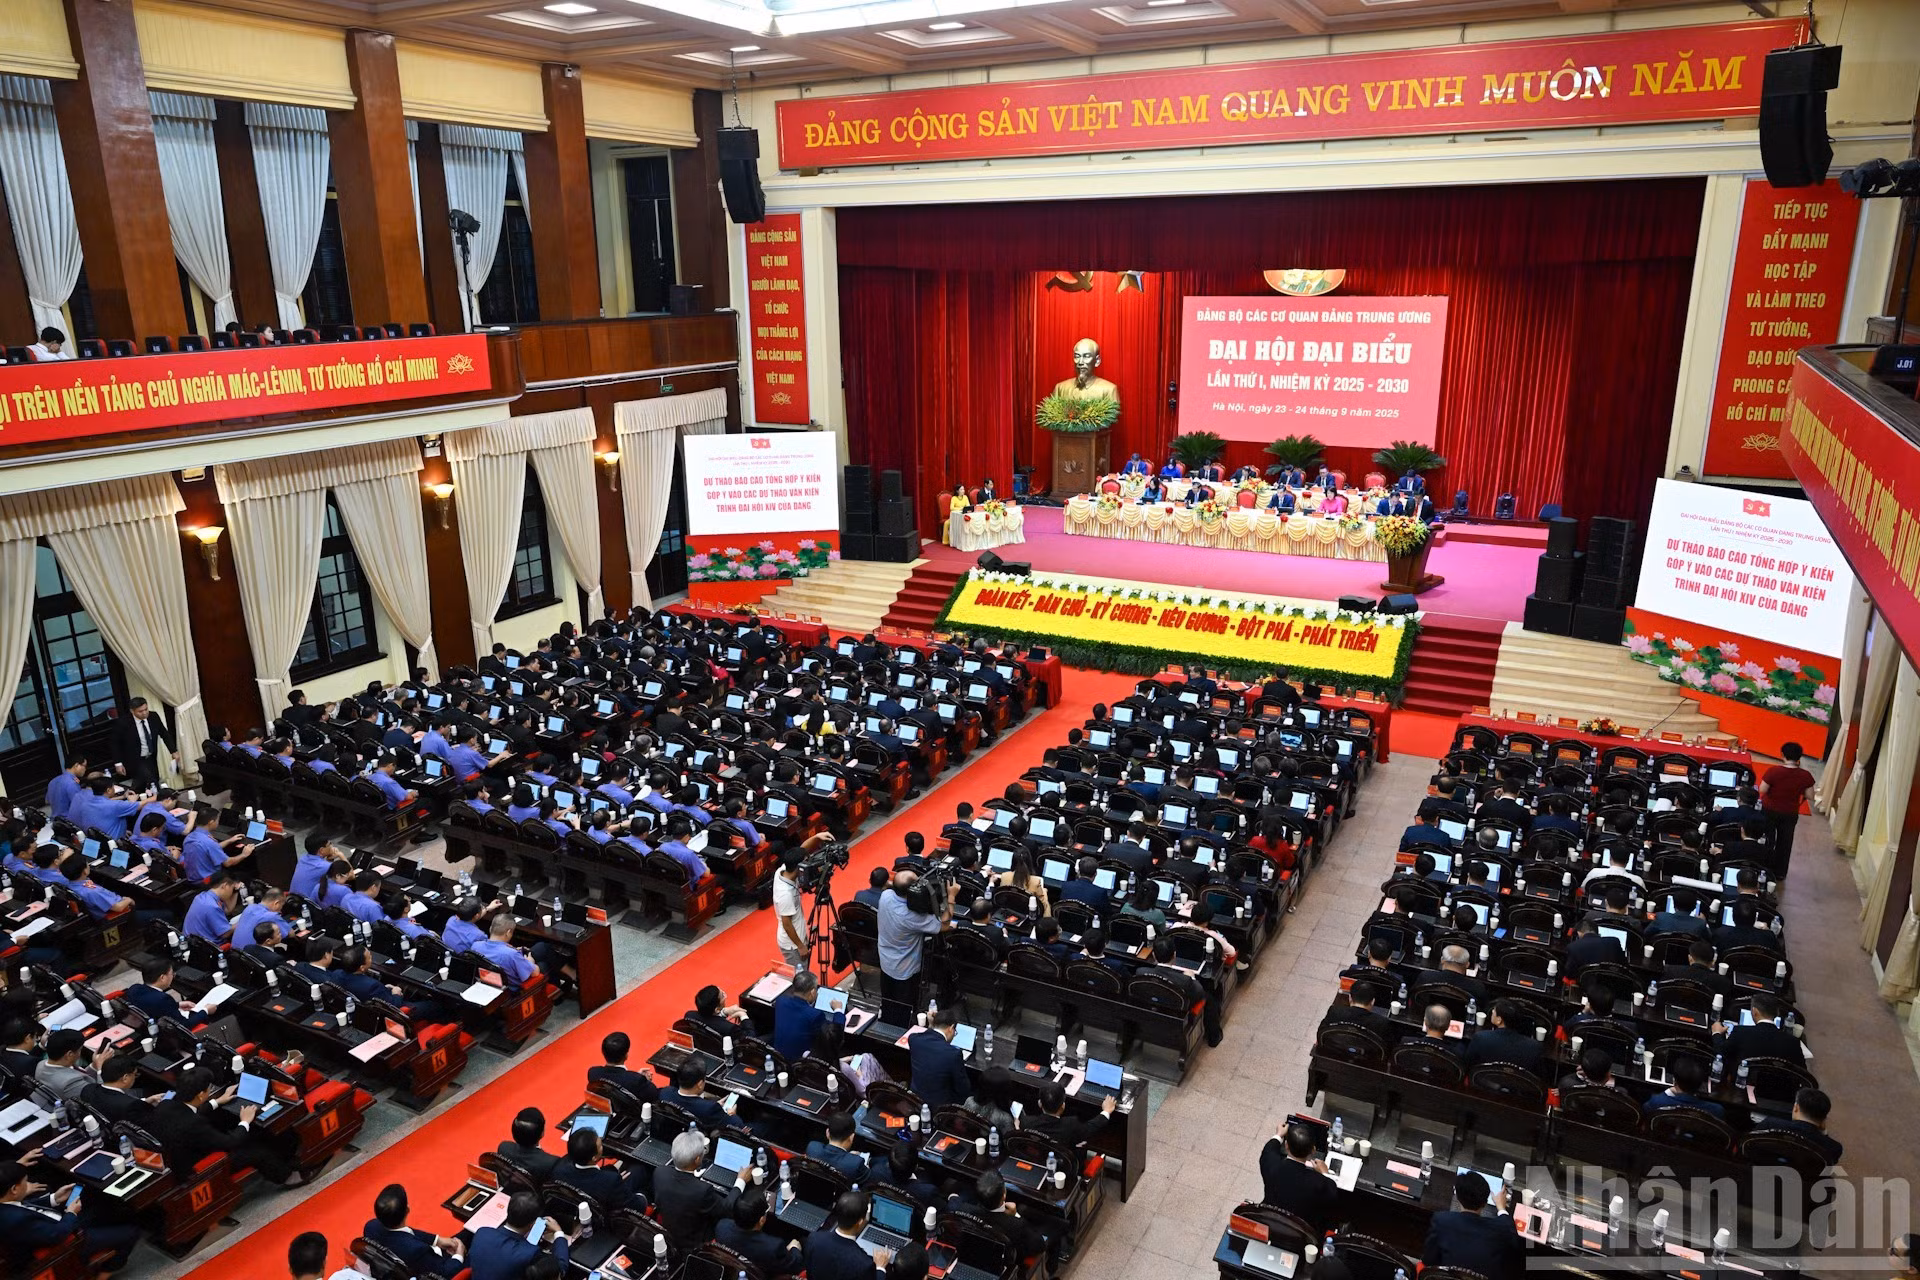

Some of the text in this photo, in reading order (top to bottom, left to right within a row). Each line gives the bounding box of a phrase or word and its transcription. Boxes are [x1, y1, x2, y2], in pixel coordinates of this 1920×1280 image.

[804, 49, 1747, 148] ĐẢNG CỘNG SẢN VIỆT NAM QUANG VINH MUÔN NĂM
[1773, 199, 1828, 222] TIẾP TỤC
[1762, 228, 1829, 252] ĐẨY MẠNH
[1764, 260, 1817, 282] HỌC TẬP
[1746, 292, 1826, 308] VÀ LÀM THEO
[1196, 307, 1432, 324] ĐẢNG BỘ CÁC CƠ QUAN ĐẢNG TRUNG ƯƠNG
[1750, 317, 1812, 339] TƯ TƯỞNG,
[1208, 332, 1412, 368] ĐẠI HỘI ĐẠI BIỂU
[1747, 350, 1772, 368] ĐẠO
[1896, 360, 1913, 368] J.01
[12, 385, 61, 422] TRÊN
[62, 378, 100, 417] NỀN
[100, 374, 146, 413] TẢNG
[146, 370, 179, 408] CHỦ
[180, 370, 228, 404] NGHĨA
[307, 365, 324, 392] TƯ
[325, 357, 366, 390] TƯỞNG
[366, 354, 384, 386] HỒ
[386, 355, 404, 384] CHÍ
[406, 358, 438, 382] MINH!
[1206, 369, 1230, 388] LẦN
[1232, 371, 1258, 389] THỨ
[1270, 374, 1310, 393] NHIỆM
[1314, 374, 1331, 392] KỲ
[1333, 377, 1365, 392] 2025
[1376, 378, 1410, 394] 2030
[1732, 378, 1774, 394] PHONG
[1212, 402, 1226, 412] Hà
[1228, 402, 1246, 414] Nội,
[1248, 404, 1272, 415] ngày
[1274, 404, 1287, 414] 23
[1295, 406, 1308, 414] 24
[1309, 405, 1339, 418] tháng
[1341, 408, 1348, 416] 9
[1349, 406, 1372, 418] năm
[1374, 408, 1400, 418] 2025
[1726, 402, 1744, 420] HỒ
[1746, 404, 1768, 421] CHÍ
[1739, 591, 1756, 606] XIV
[974, 587, 1008, 608] ĐOÀN
[1006, 590, 1032, 610] KẾT
[1033, 594, 1059, 614] DÂN
[1060, 595, 1088, 618] CHỦ
[1090, 597, 1112, 620] KỶ
[1110, 602, 1153, 625] CƯƠNG
[1158, 607, 1186, 628] NÊU
[1186, 612, 1230, 634] GƯƠNG
[1236, 616, 1266, 640] ĐỘT
[1263, 620, 1294, 642] PHÁ
[1300, 622, 1338, 648] PHÁT
[1338, 626, 1380, 653] TRIỂN
[107, 930, 118, 944] K
[434, 1052, 446, 1070] K
[325, 1116, 336, 1133] L
[194, 1184, 210, 1208] M
